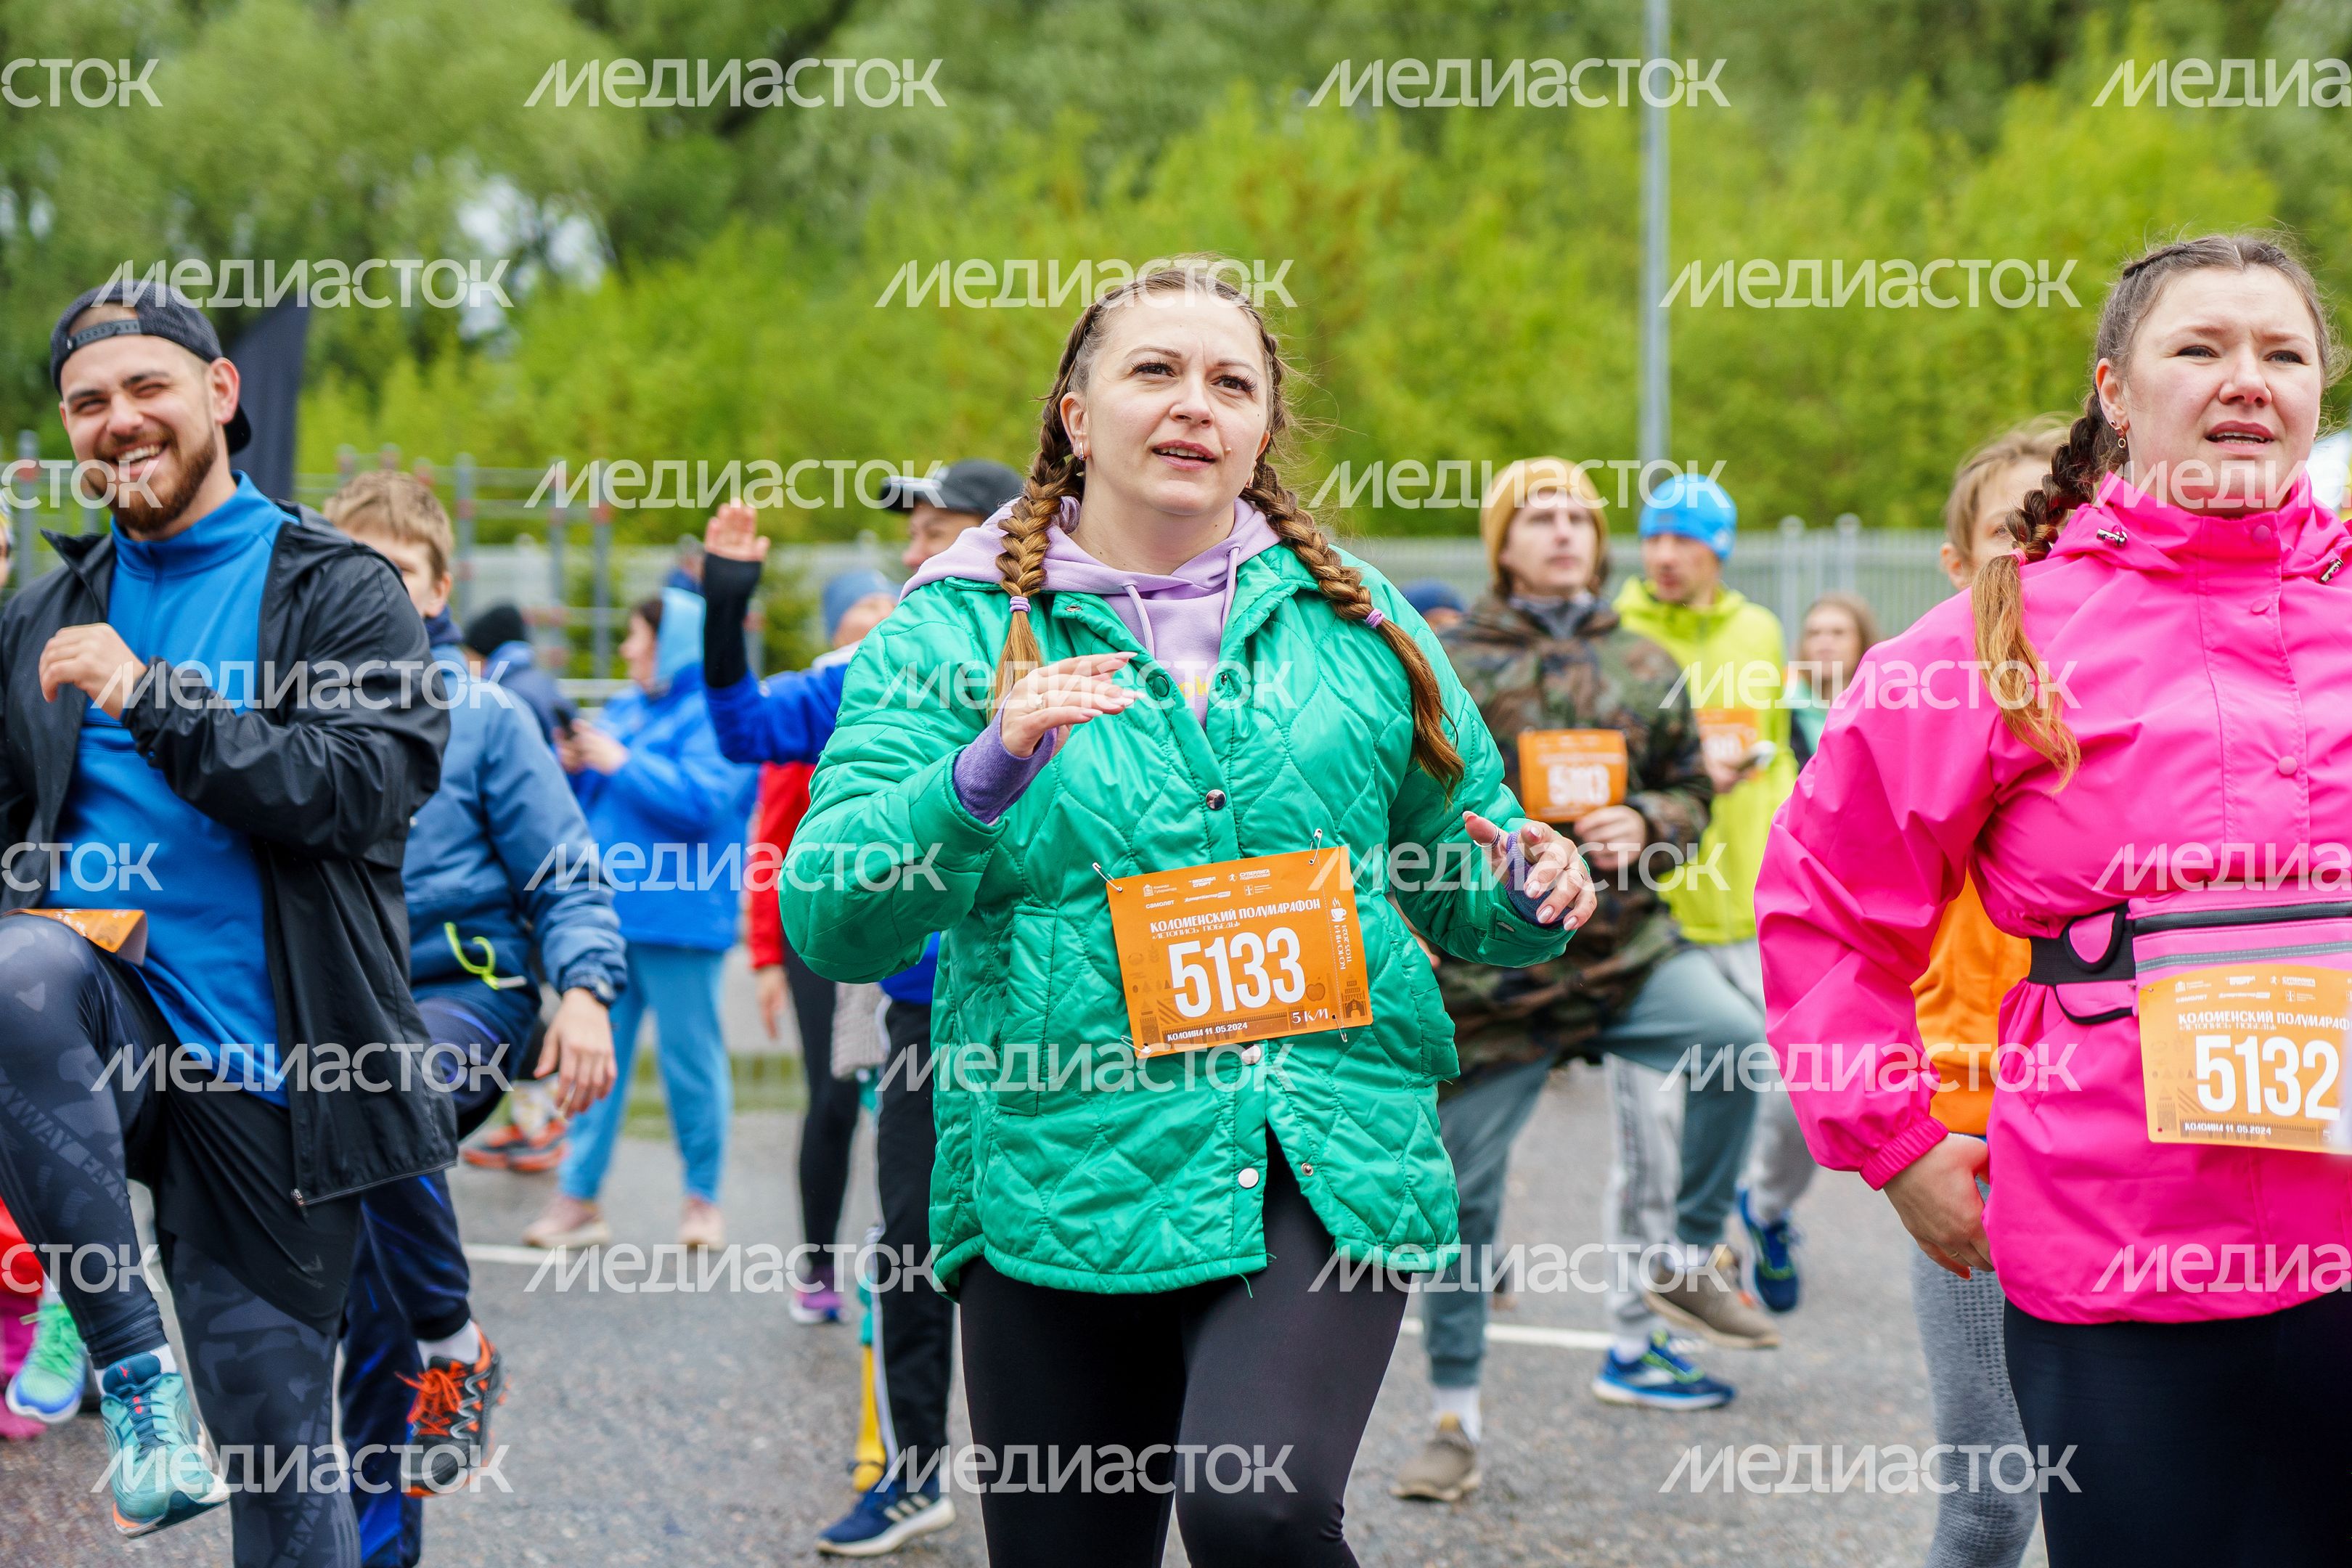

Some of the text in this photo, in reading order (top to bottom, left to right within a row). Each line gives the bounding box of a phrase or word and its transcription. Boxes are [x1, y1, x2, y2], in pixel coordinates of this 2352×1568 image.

[1150, 898, 1320, 934] КОЛОМЕНСКИЙ ПОЛУМАРАФОН
[1168, 927, 1306, 1018] 5133
[2178, 1010, 2273, 1024] КОЛОМЕНСКИЙ
[1167, 1029, 1204, 1042] КОЛОМНА
[2195, 1035, 2341, 1121] 5132
